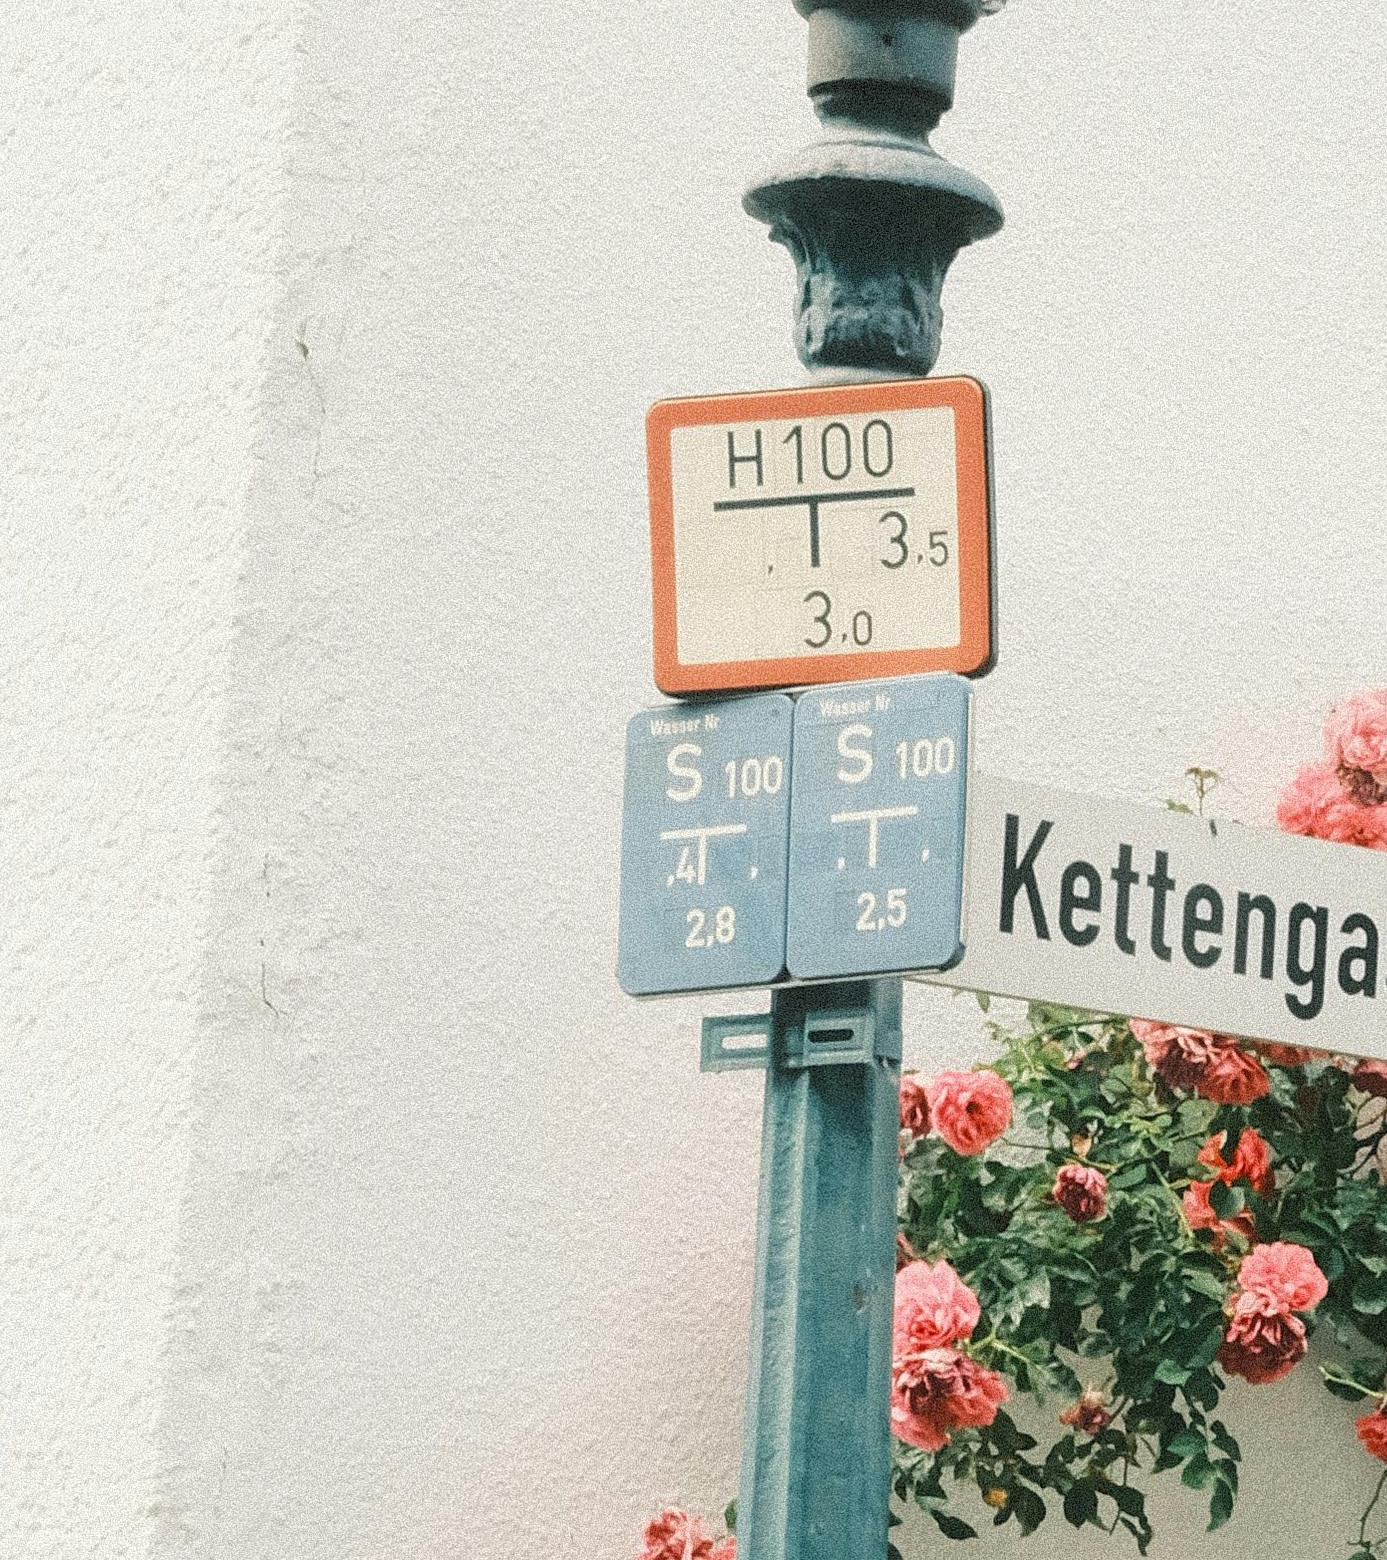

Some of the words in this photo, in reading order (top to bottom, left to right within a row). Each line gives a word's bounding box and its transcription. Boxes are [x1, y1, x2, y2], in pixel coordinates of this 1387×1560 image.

[879, 511, 949, 569] 3,5
[803, 590, 873, 648] 3,0
[666, 743, 703, 801] S
[725, 757, 783, 799] 100
[836, 724, 873, 783] S
[896, 737, 955, 778] 100
[685, 905, 736, 949] 2,8
[855, 888, 907, 931] 2,5
